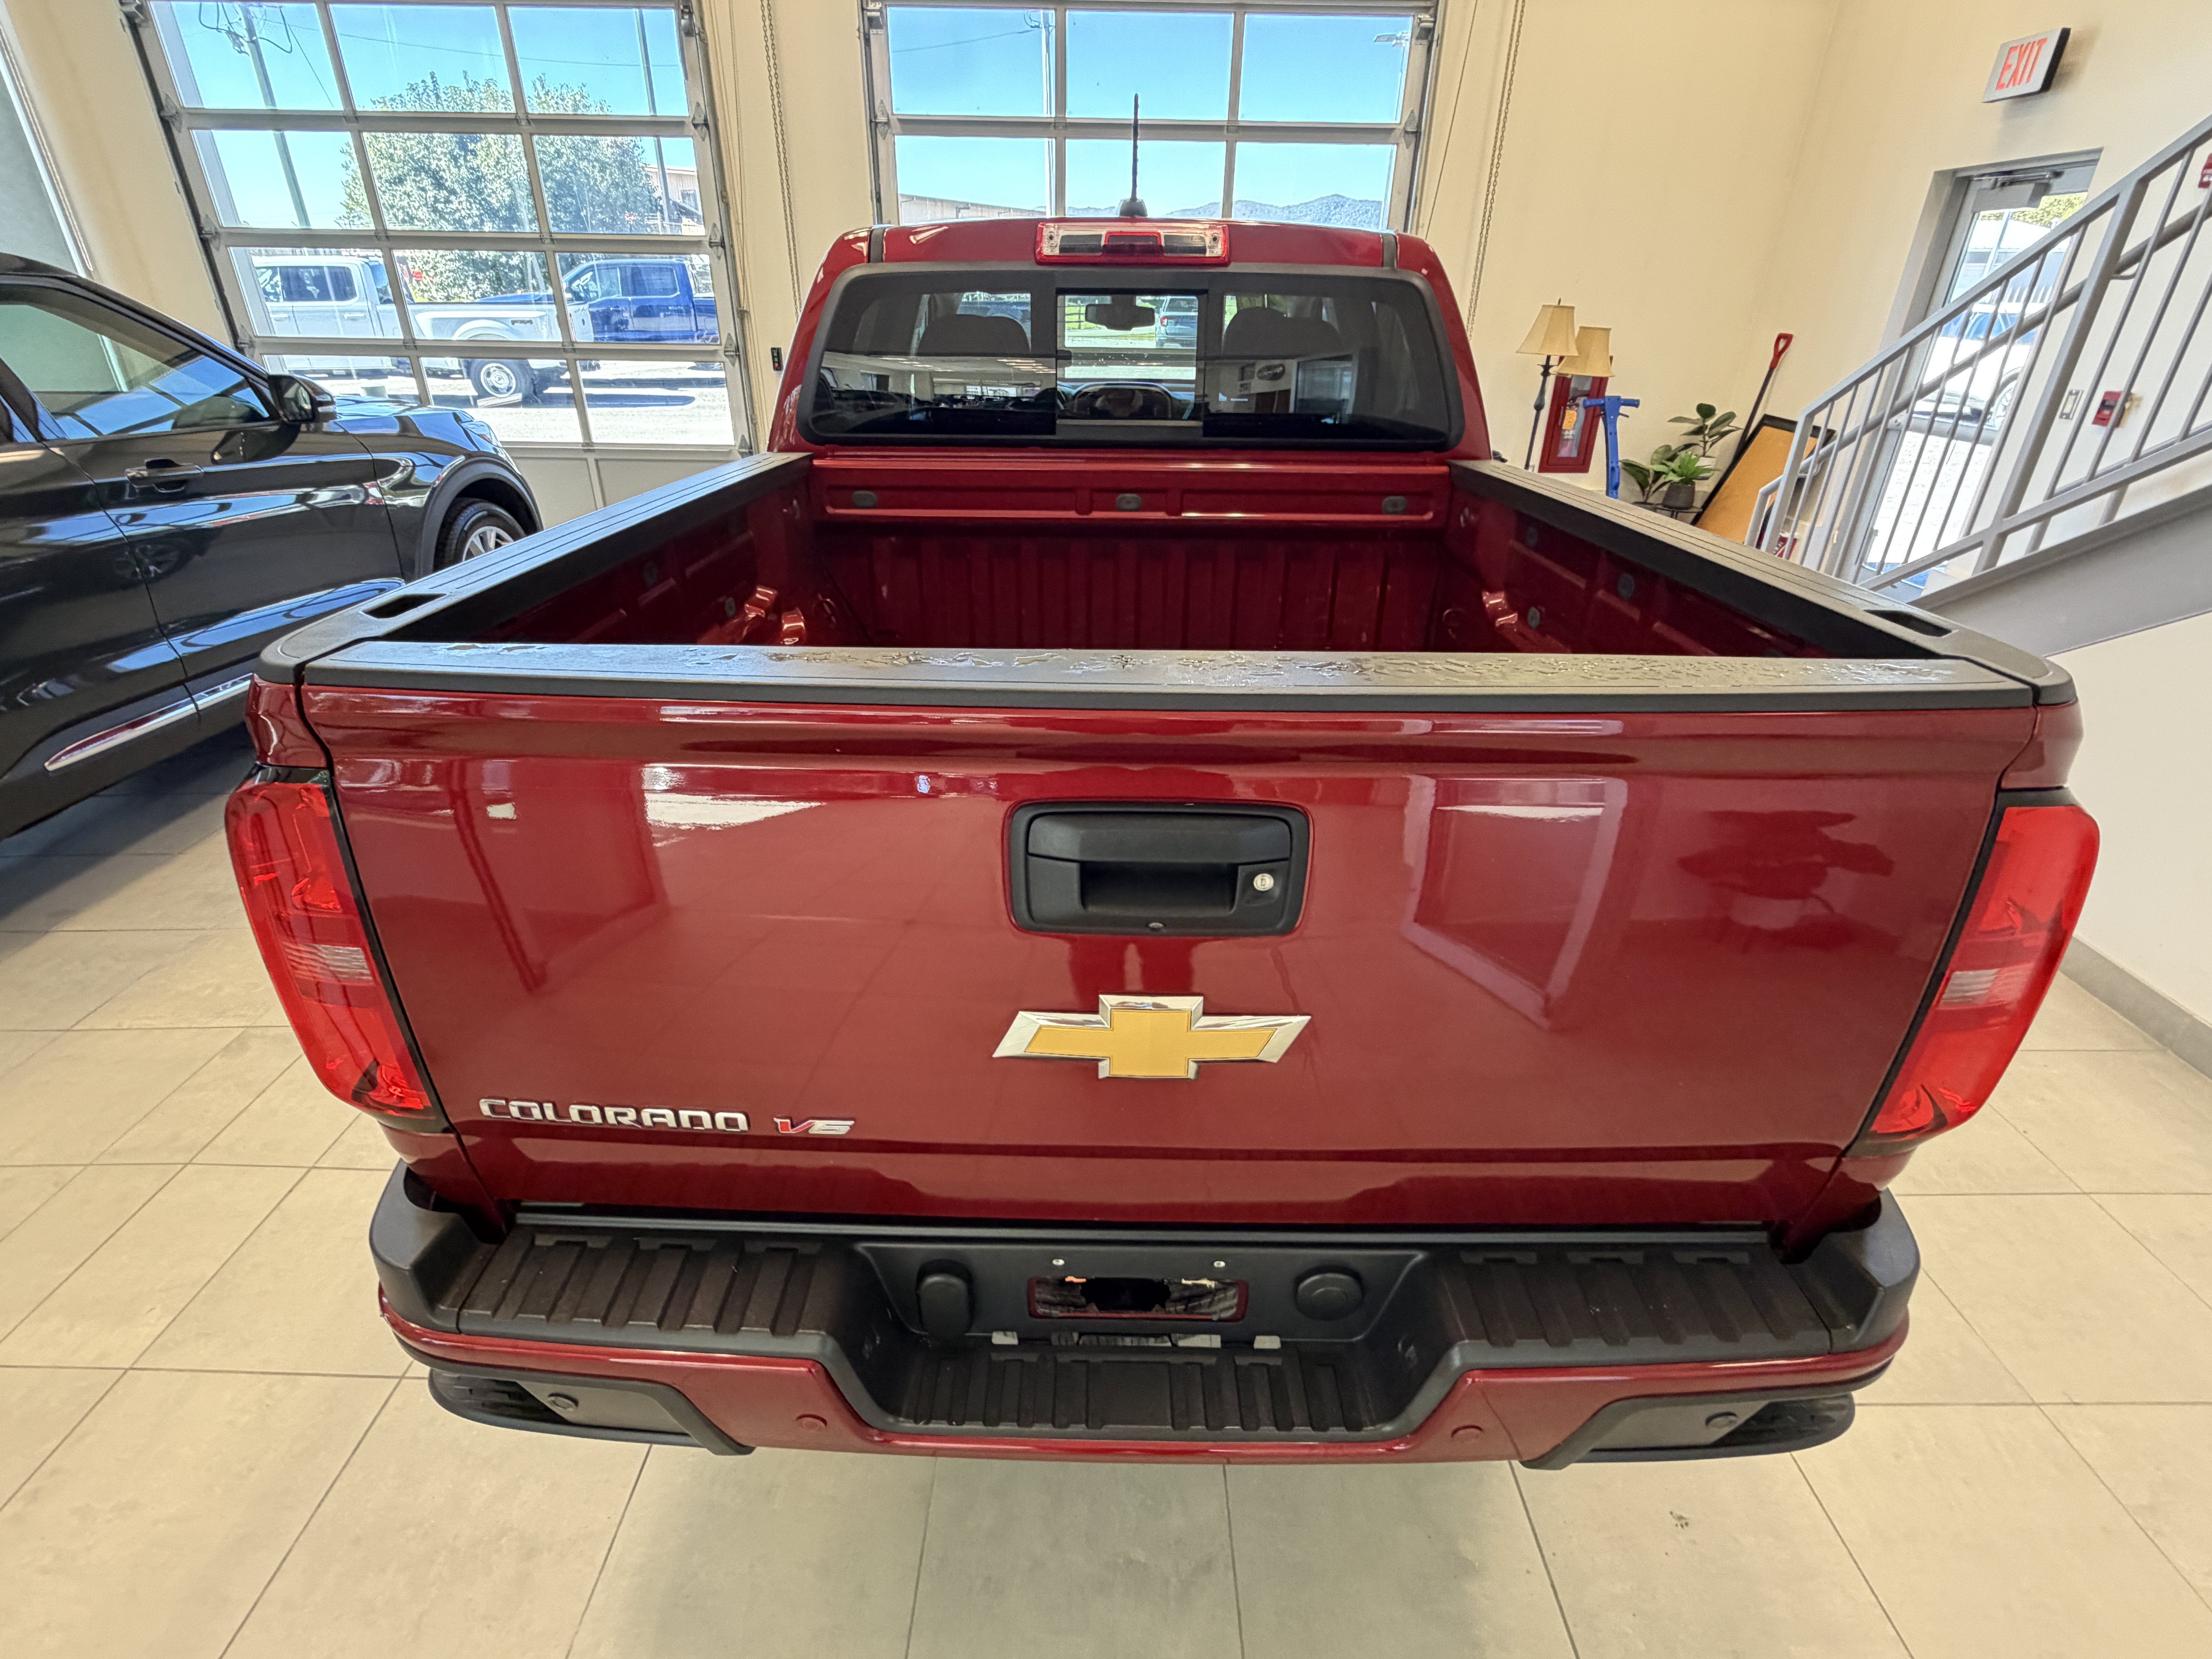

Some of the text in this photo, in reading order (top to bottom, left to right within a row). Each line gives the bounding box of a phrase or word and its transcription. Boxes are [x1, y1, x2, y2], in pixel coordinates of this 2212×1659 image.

[1996, 37, 2048, 90] EXIT
[479, 1098, 855, 1134] COLORADO V6
